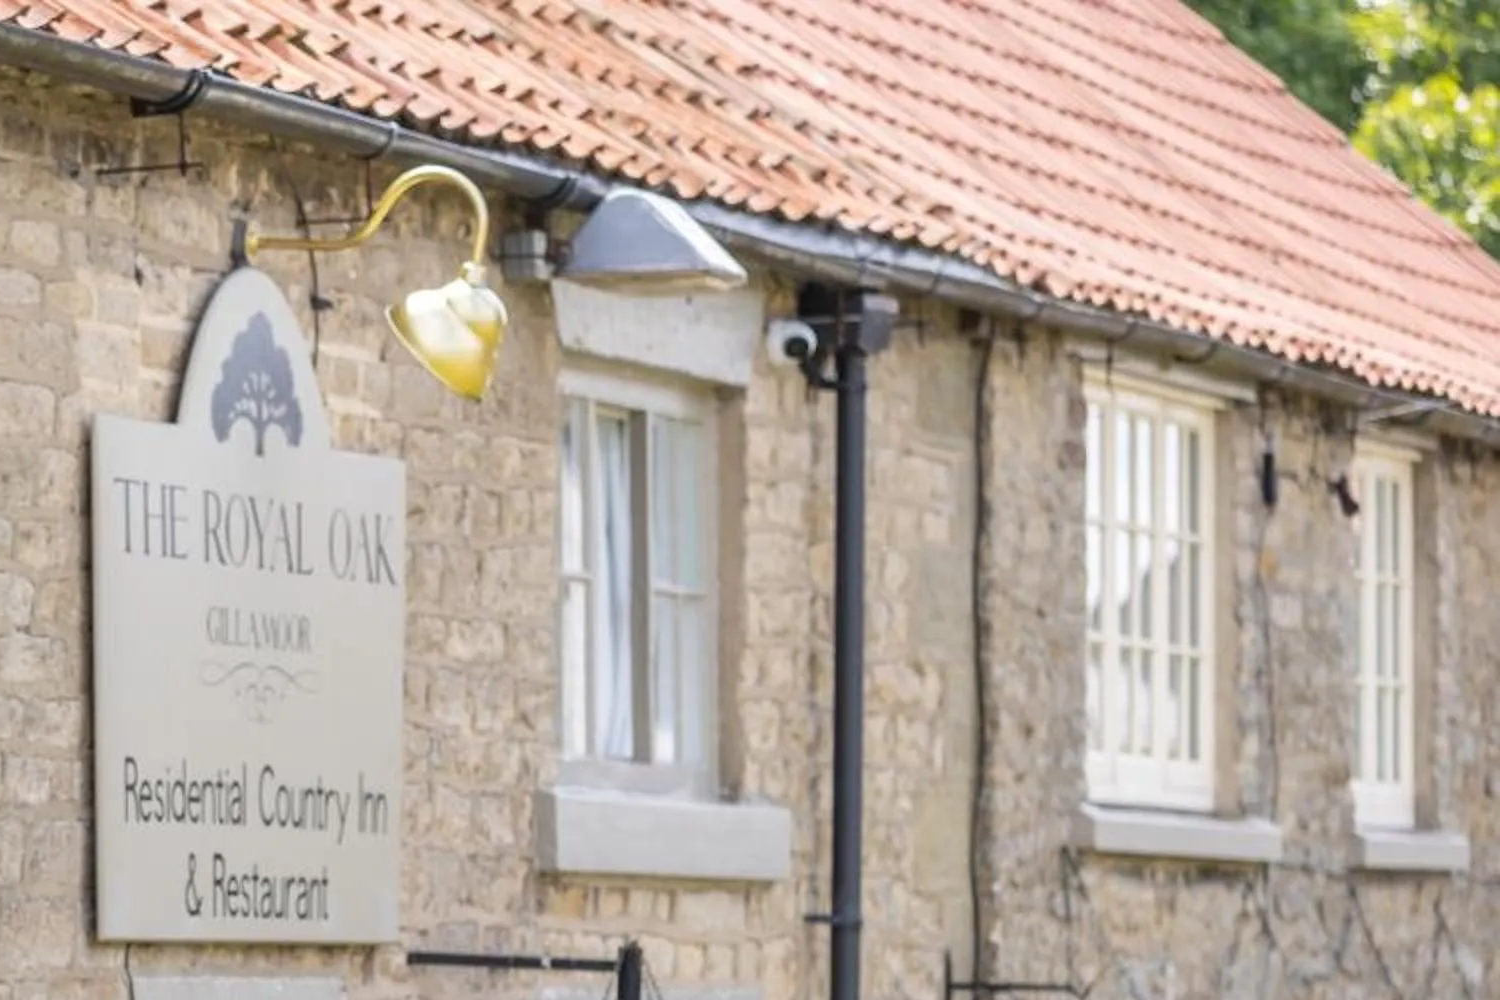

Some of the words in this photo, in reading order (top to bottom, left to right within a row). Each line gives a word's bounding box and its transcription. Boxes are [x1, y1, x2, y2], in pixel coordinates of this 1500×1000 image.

[113, 477, 189, 560] THE
[202, 488, 314, 576] ROYAL
[328, 507, 397, 586] OAK
[205, 606, 312, 652] GILLAMOOR
[124, 756, 247, 826] Residential
[258, 764, 350, 846] Country
[357, 770, 388, 834] Inn
[185, 852, 203, 917] &
[212, 852, 329, 921] Restaurant
